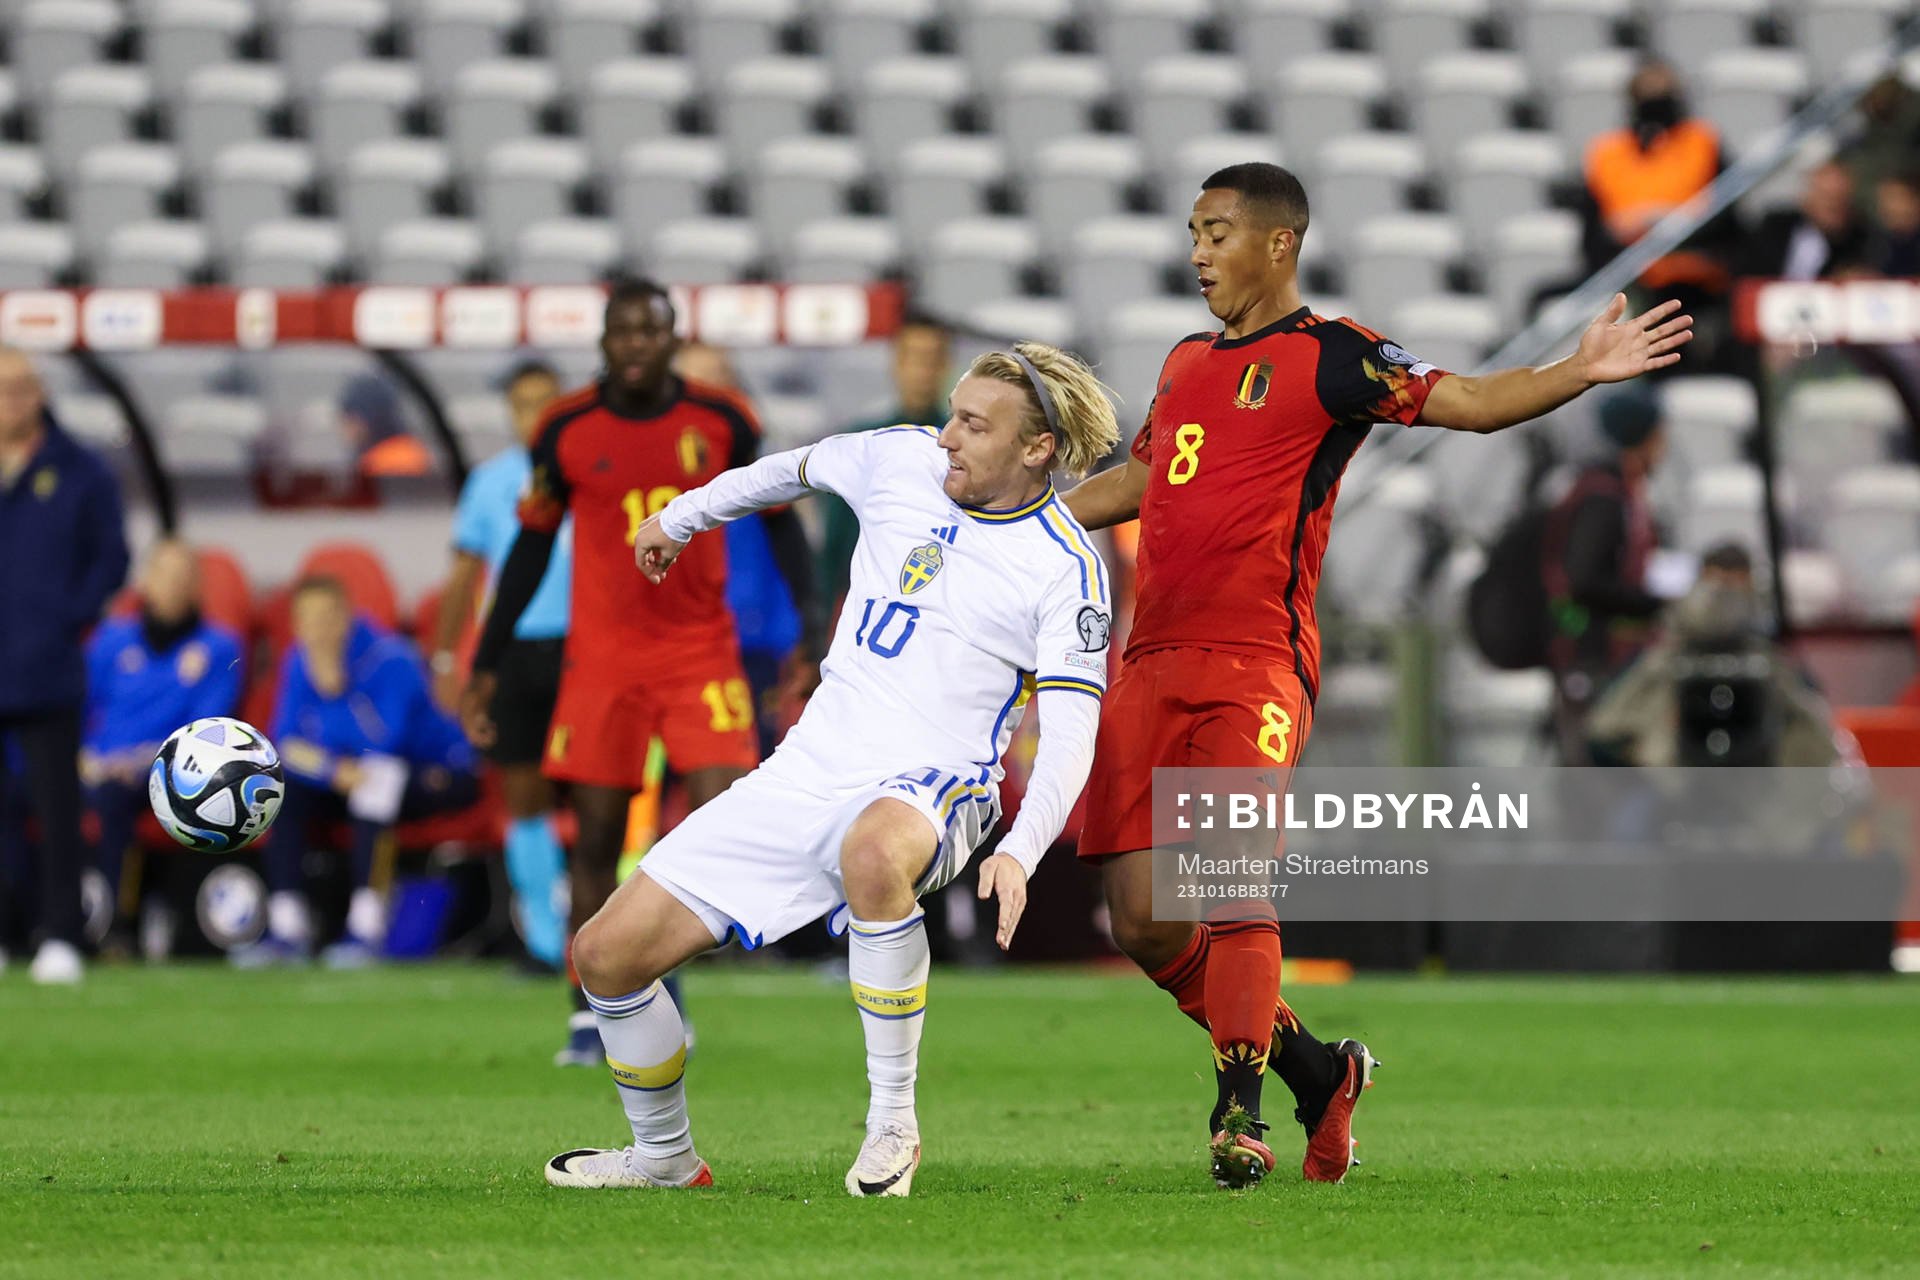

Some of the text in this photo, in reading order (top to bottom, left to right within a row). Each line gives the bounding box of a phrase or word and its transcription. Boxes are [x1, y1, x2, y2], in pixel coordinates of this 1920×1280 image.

[1167, 423, 1205, 486] 8
[856, 597, 920, 659] 10
[701, 678, 754, 733] 19
[1257, 701, 1292, 763] 8
[858, 991, 918, 1007] SVERIGE
